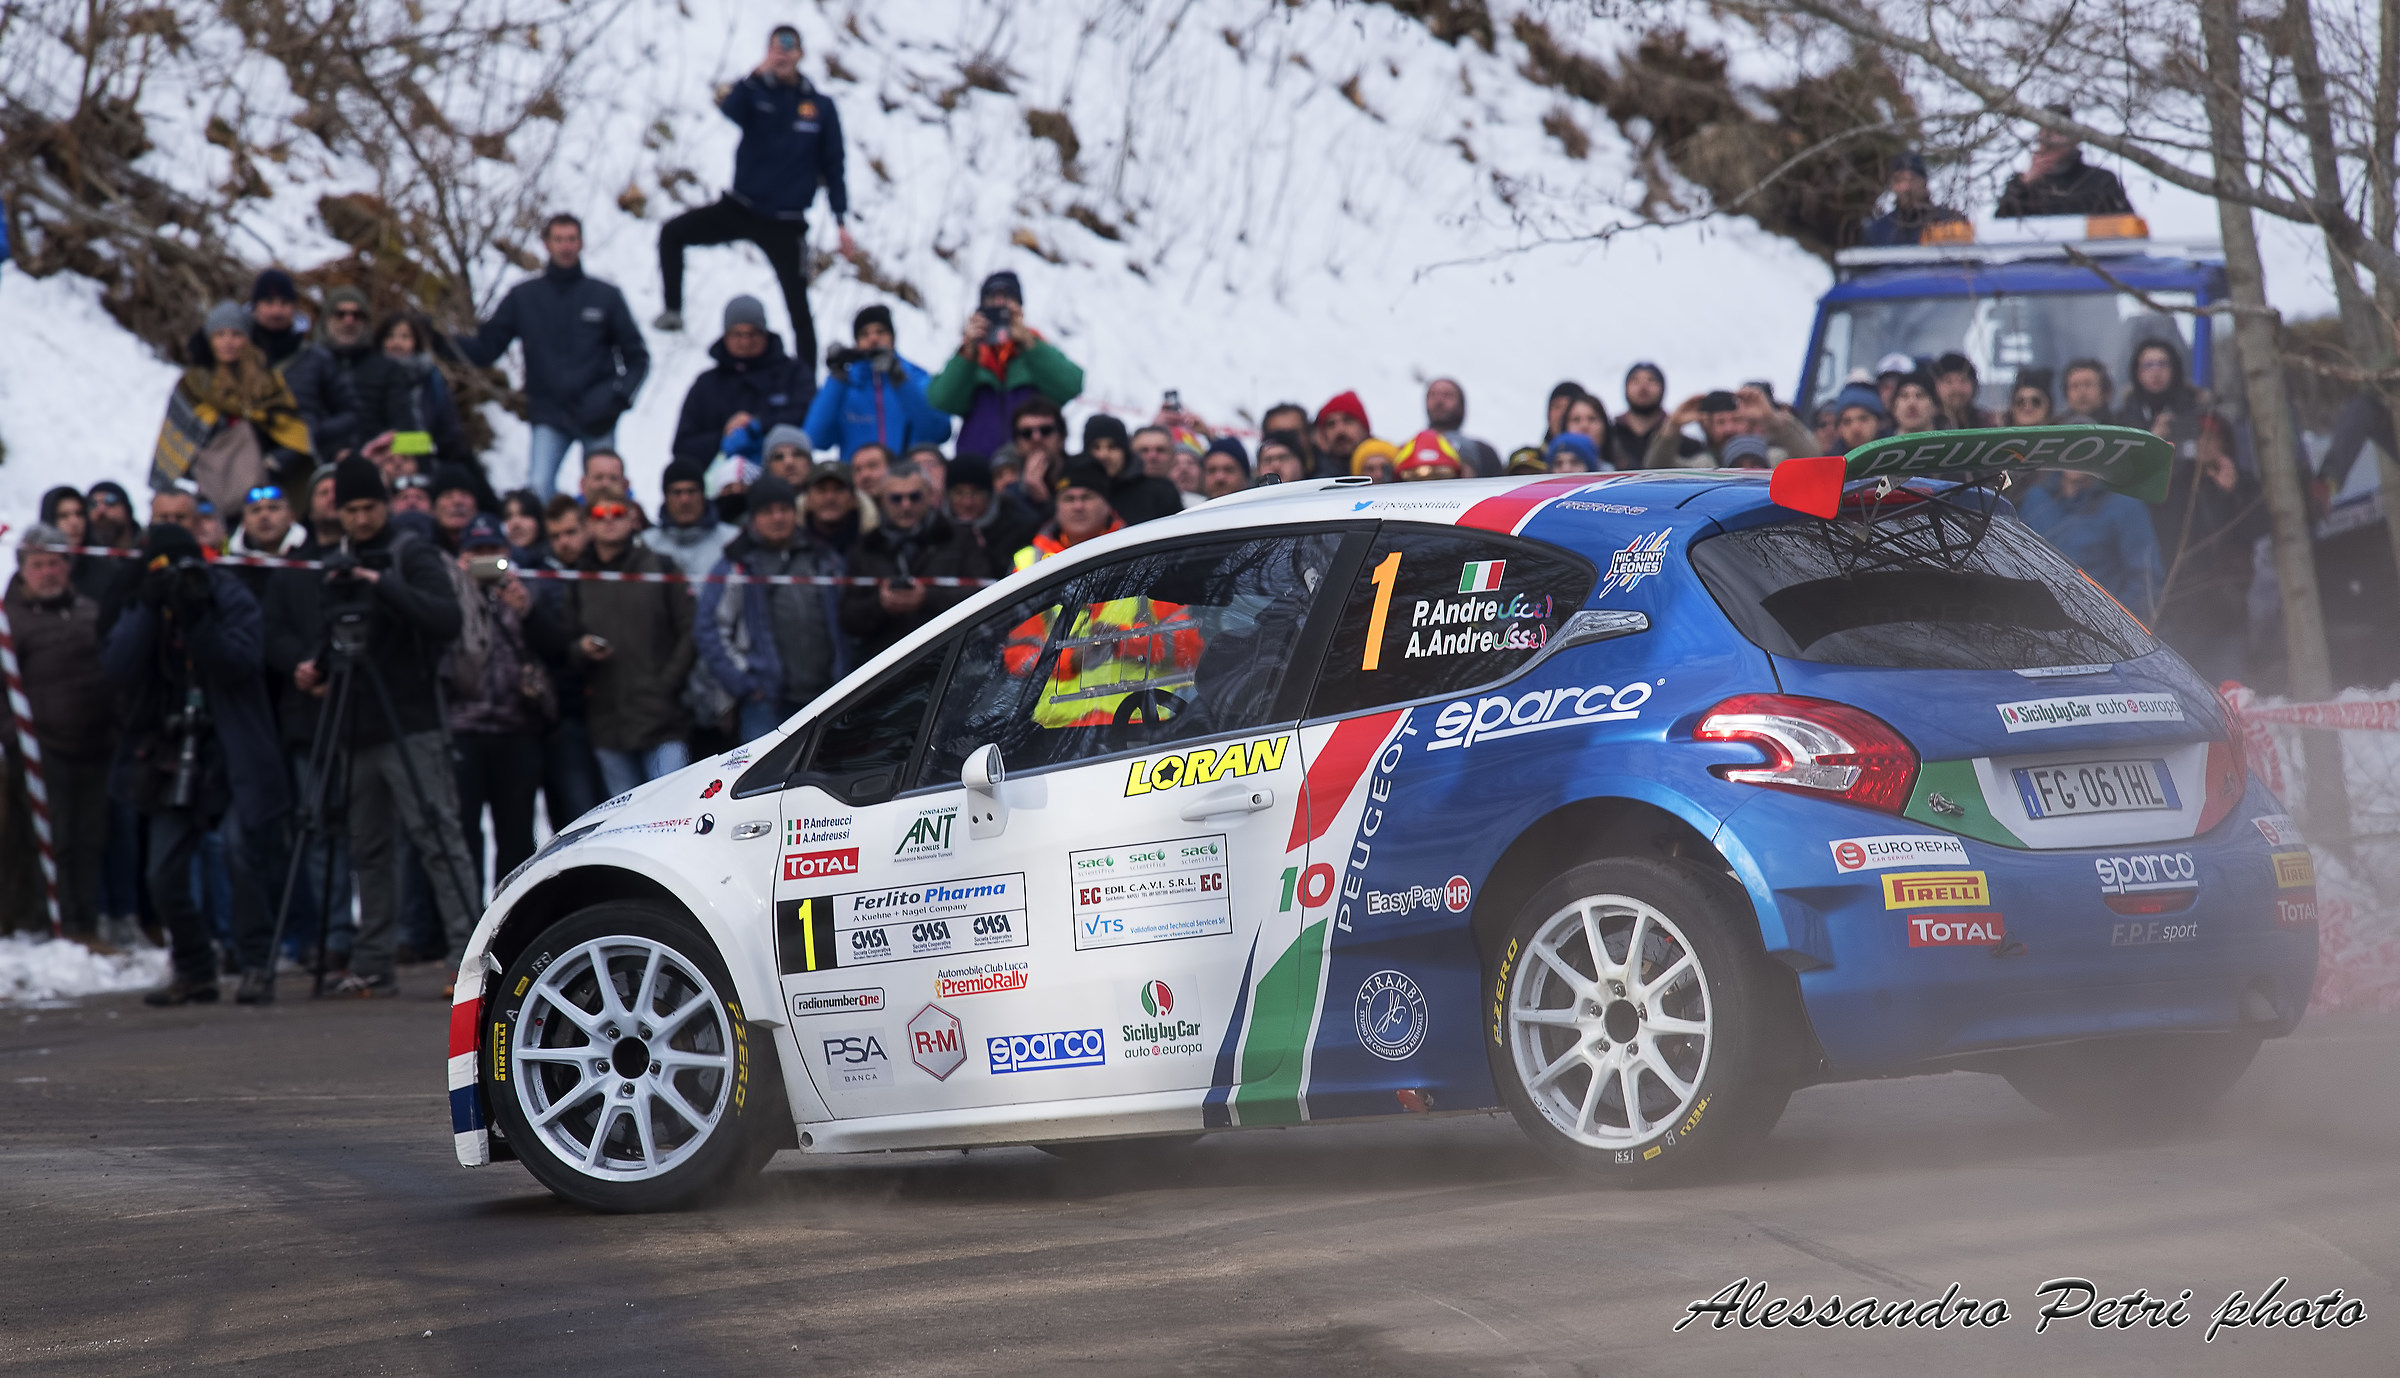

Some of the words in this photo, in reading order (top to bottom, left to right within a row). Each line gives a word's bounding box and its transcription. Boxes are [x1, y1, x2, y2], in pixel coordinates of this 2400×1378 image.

[1863, 436, 2146, 477] PEUGEOT
[1613, 561, 1660, 574] LEONES
[1615, 552, 1633, 563] HIC
[1634, 551, 1662, 562] SUNT
[1362, 552, 1403, 671] 1
[1434, 681, 1654, 749] sparco
[1124, 736, 1290, 798] LORAN
[803, 815, 852, 829] P.Andreucci
[894, 813, 957, 856] ANT
[1337, 707, 1419, 934] PEUGEOT
[802, 829, 850, 844] A.Andreussi
[1867, 842, 1913, 855] EURO
[1915, 840, 1963, 854] REPAR
[786, 855, 856, 877] TOTAL
[1888, 854, 1915, 862] SERVICE
[2095, 852, 2196, 894] sparco
[853, 890, 921, 911] Ferlito
[925, 883, 1006, 903] Pharma
[1079, 886, 1102, 906] EC
[1105, 885, 1126, 895] EDIL
[1199, 872, 1222, 892] EC
[1367, 884, 1443, 915] EasyPay
[1891, 876, 1981, 903] PIRELLI
[862, 911, 892, 922] Kuehne
[902, 907, 928, 917] Nagel
[929, 903, 968, 914] Company
[1158, 922, 1169, 931] and
[798, 898, 817, 971] 1
[1911, 918, 2002, 942] TOTAL
[2162, 920, 2198, 942] sport
[937, 966, 983, 979] Automobile
[984, 962, 1003, 974] Club
[1005, 961, 1029, 971] Lucca
[942, 970, 1029, 994] PremioRally
[1360, 973, 1422, 1006] STRAMBI
[1359, 1009, 1369, 1037] STUDIO
[1366, 1036, 1373, 1045] DI
[1372, 1043, 1411, 1056] CONSULENZA
[1409, 1013, 1424, 1049] AZIENDALE
[493, 1022, 507, 1082] PIRELLI
[823, 1035, 888, 1066] PSA
[990, 1030, 1103, 1071] sparco
[844, 1073, 878, 1083] BANCA
